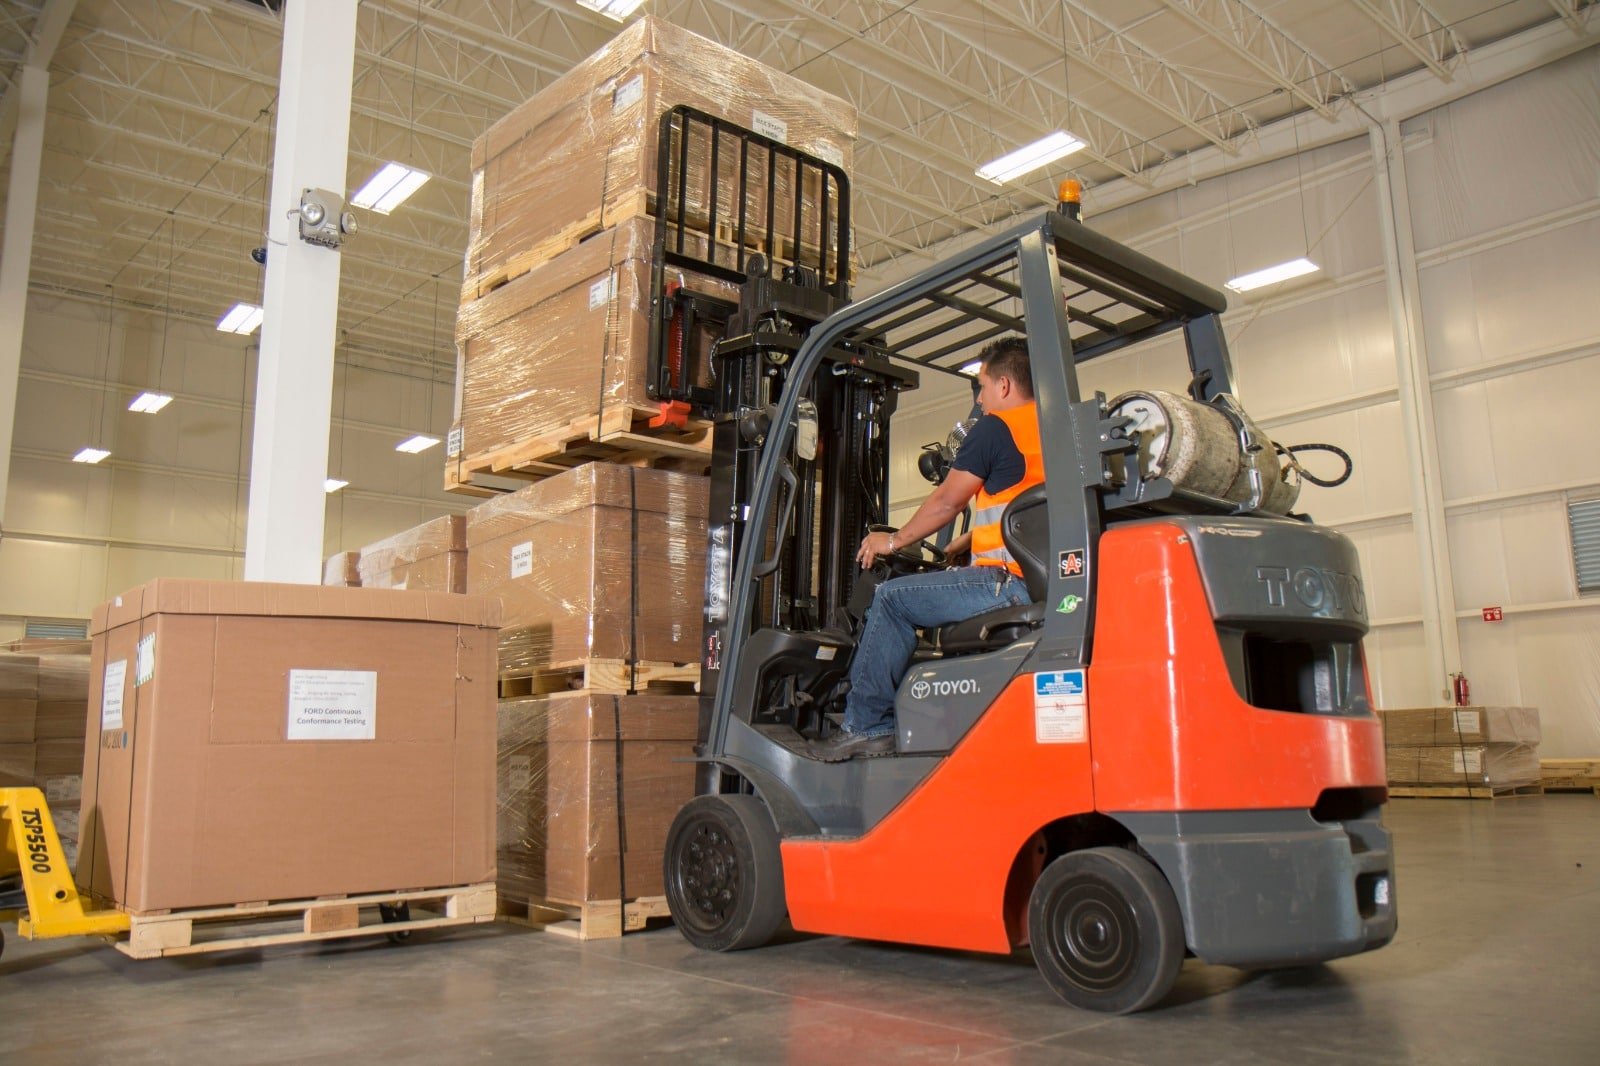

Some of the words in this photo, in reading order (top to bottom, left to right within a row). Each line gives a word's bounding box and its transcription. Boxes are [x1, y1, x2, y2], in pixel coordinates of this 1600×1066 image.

[708, 525, 725, 623] TOYOTA
[932, 679, 981, 696] TOYOT
[304, 707, 324, 715] FORD
[297, 717, 341, 725] Conformance
[343, 718, 366, 726] Testing
[21, 807, 51, 874] TSP5500
